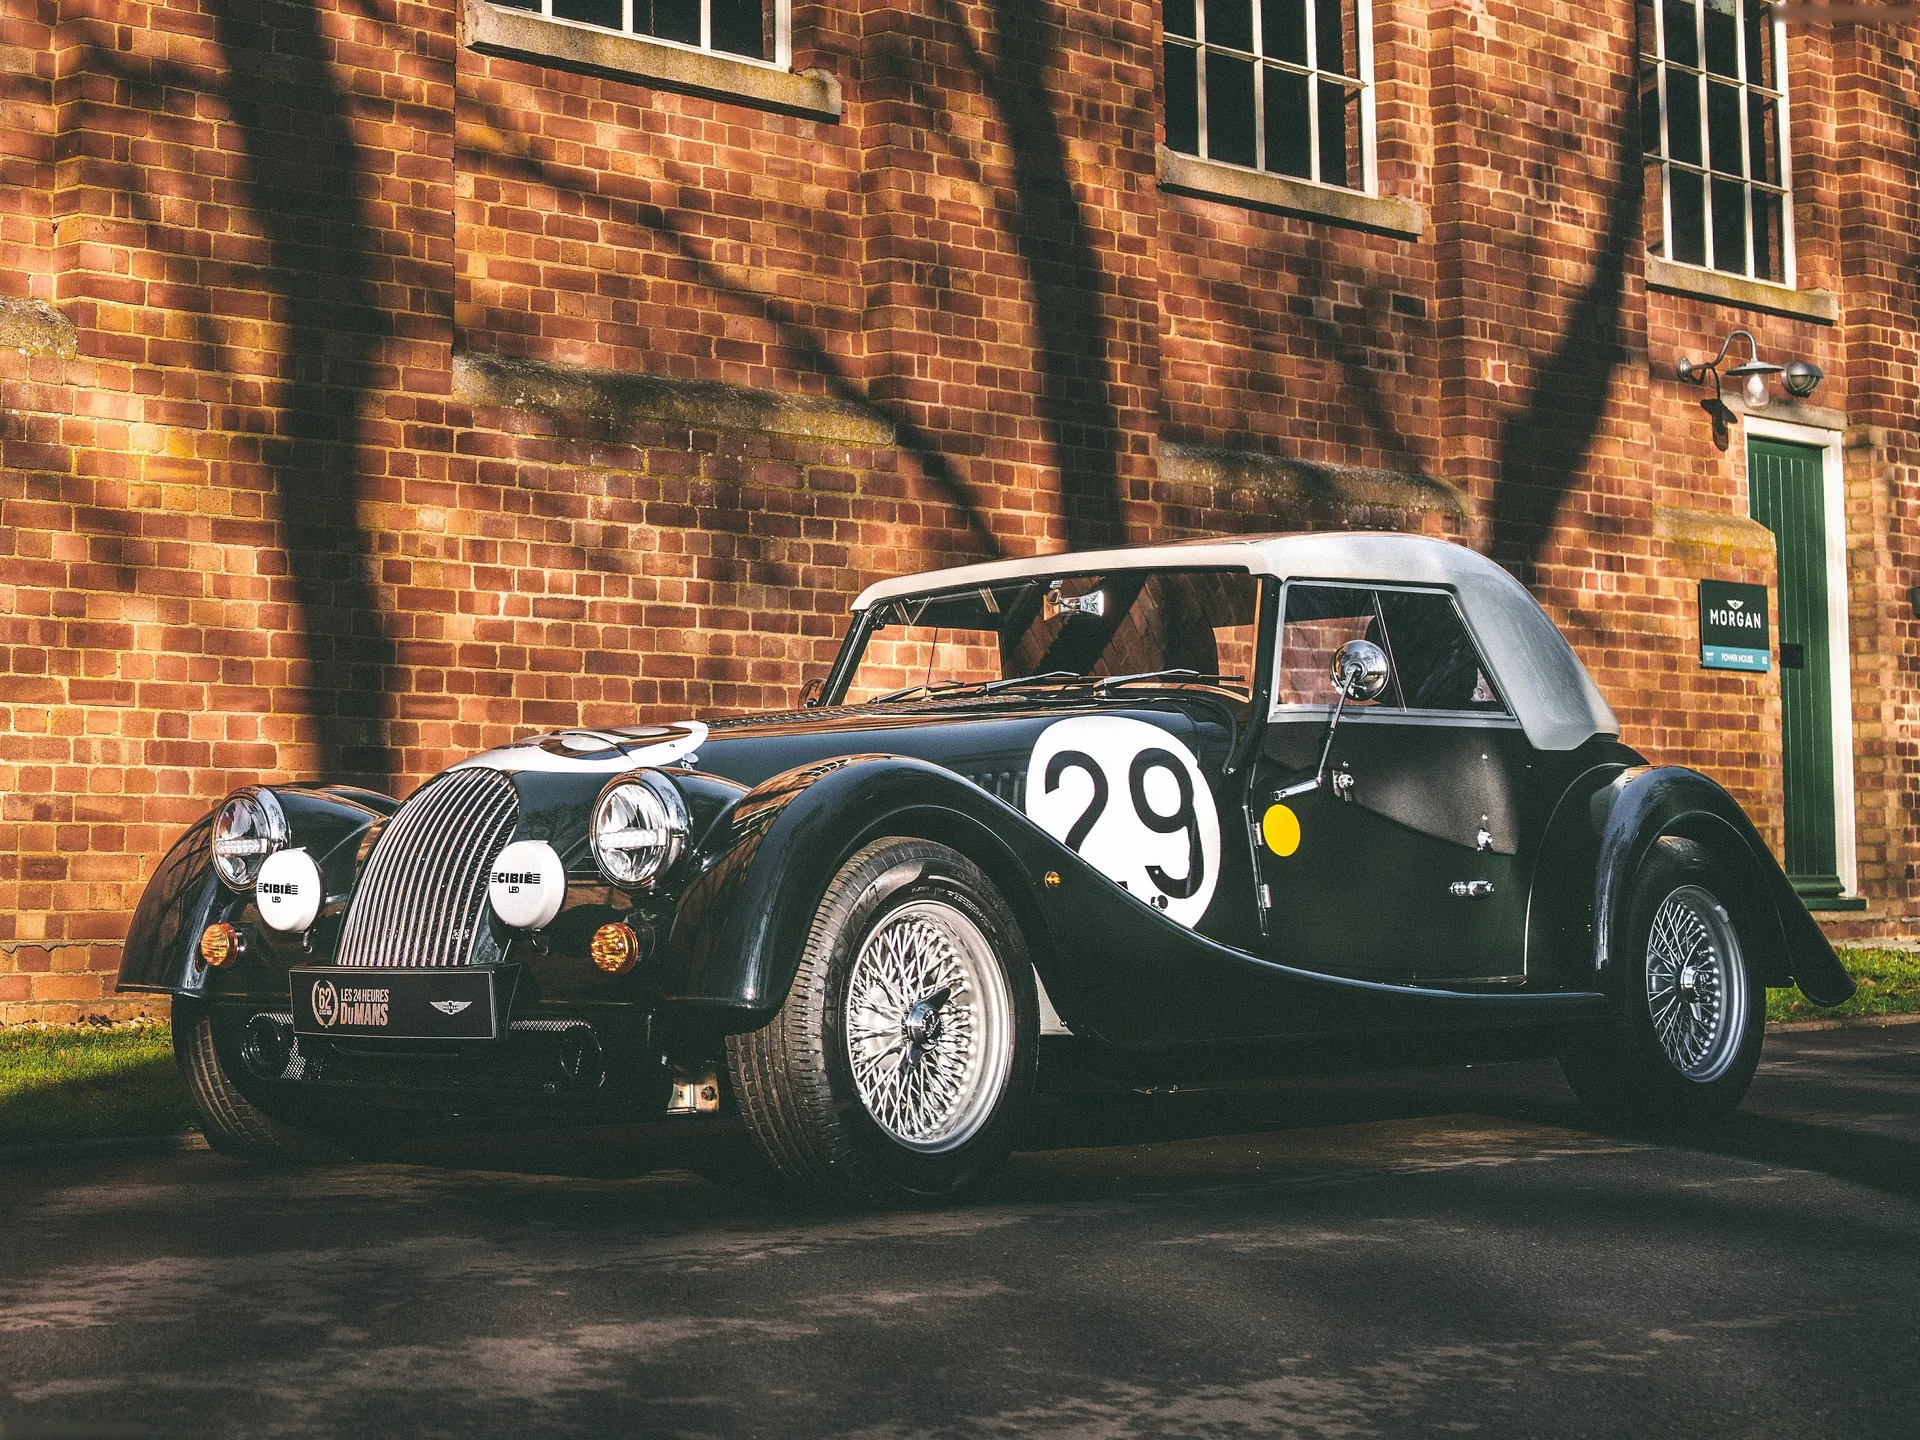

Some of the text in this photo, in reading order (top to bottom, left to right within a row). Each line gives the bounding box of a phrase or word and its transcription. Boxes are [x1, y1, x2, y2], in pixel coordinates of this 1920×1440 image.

[1710, 609, 1761, 629] MORGAN
[1721, 652, 1754, 664] POWER HOUSE
[340, 988, 389, 1003] LES 24 HEURES
